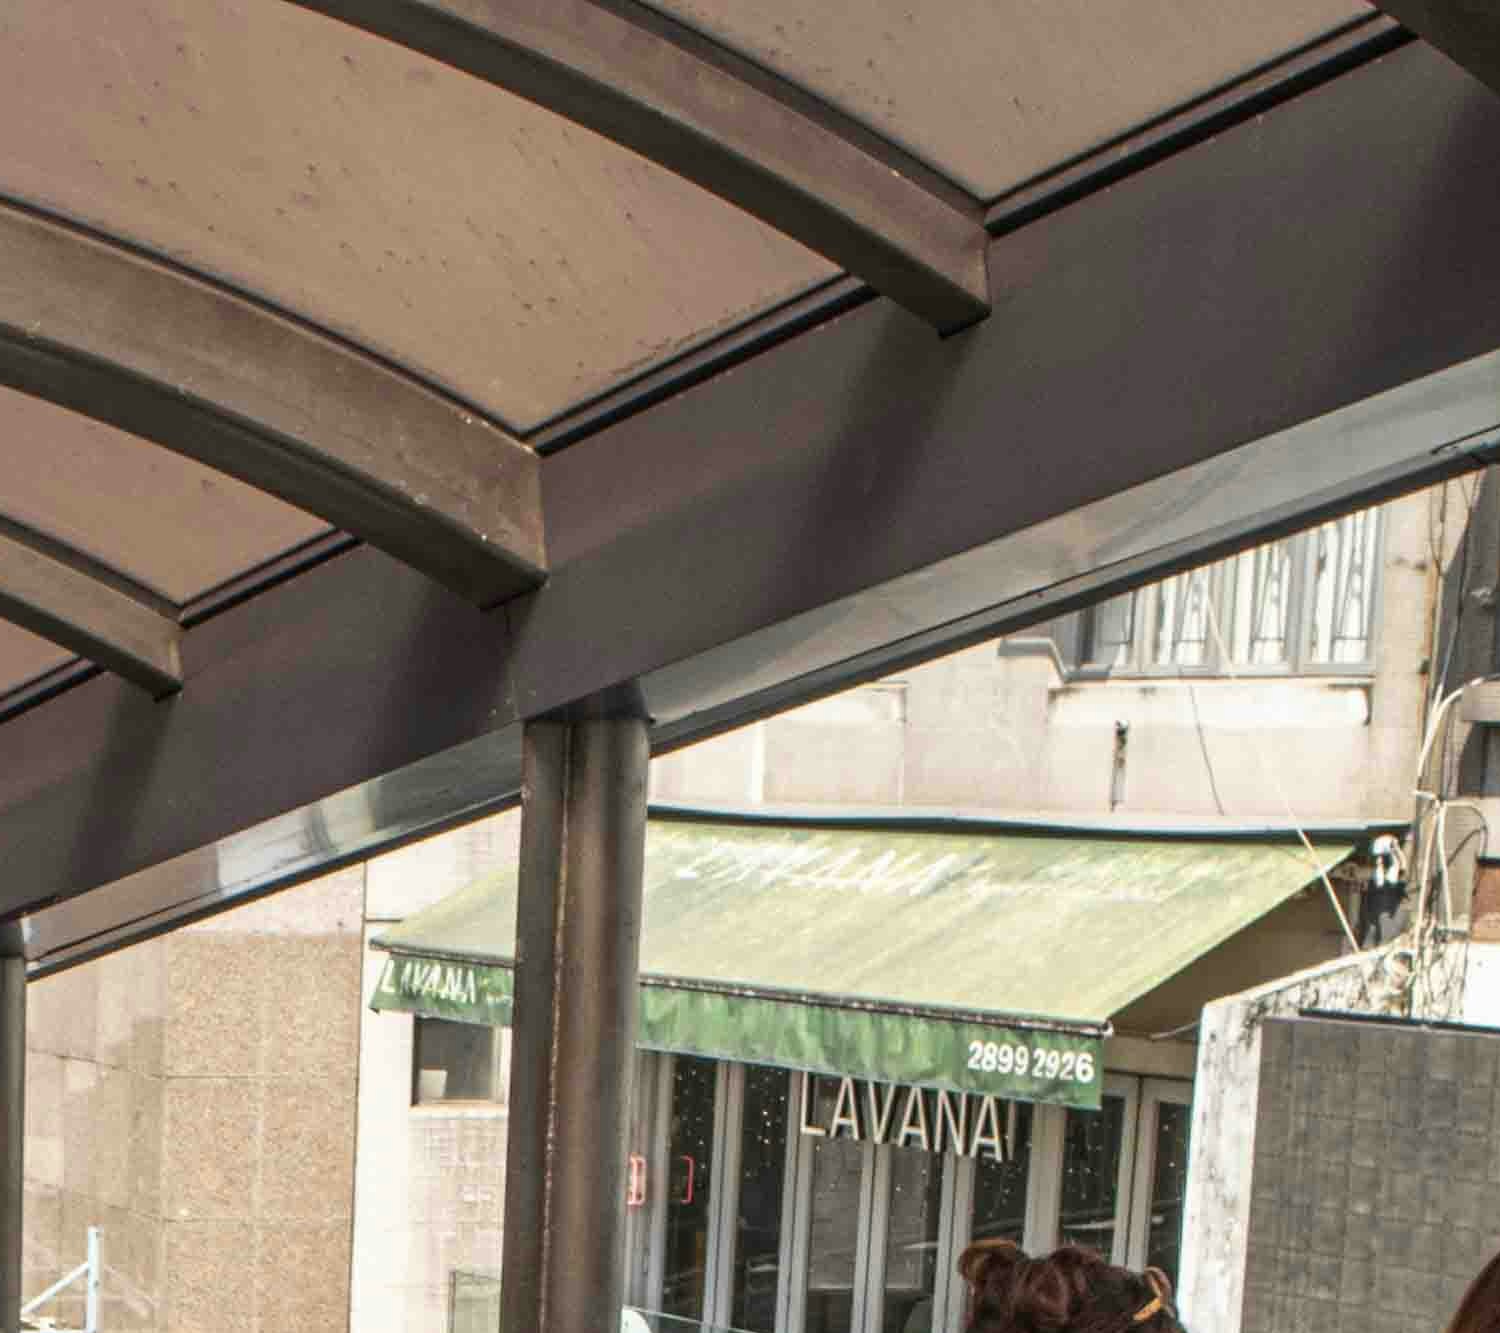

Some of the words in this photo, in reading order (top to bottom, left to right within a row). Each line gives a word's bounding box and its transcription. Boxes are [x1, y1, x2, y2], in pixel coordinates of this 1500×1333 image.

[968, 1040, 1028, 1075] 2899
[1032, 1048, 1095, 1083] 2926
[800, 1072, 1002, 1162] LAVANA
